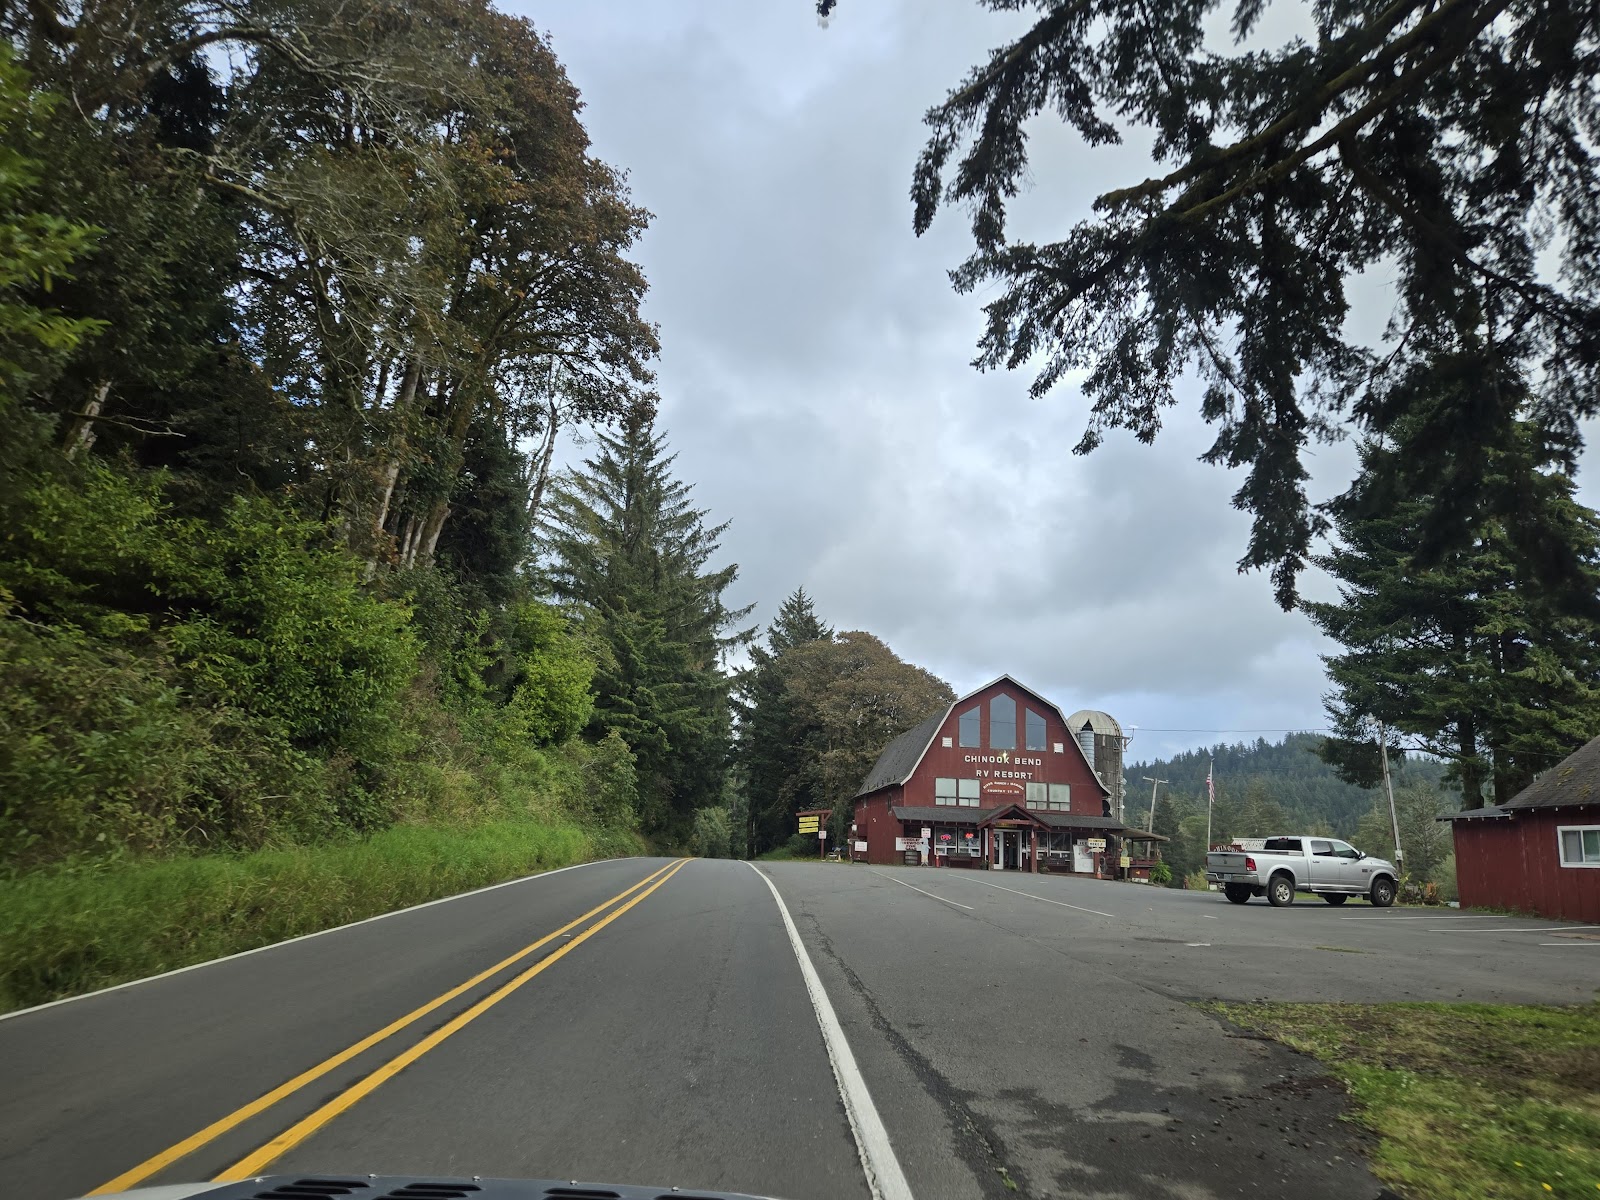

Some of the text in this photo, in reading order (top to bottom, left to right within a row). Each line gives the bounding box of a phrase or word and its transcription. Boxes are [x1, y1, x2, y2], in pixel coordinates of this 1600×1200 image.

[964, 755, 1042, 766] CHINOOK BEND
[976, 769, 1033, 780] RV RESORT
